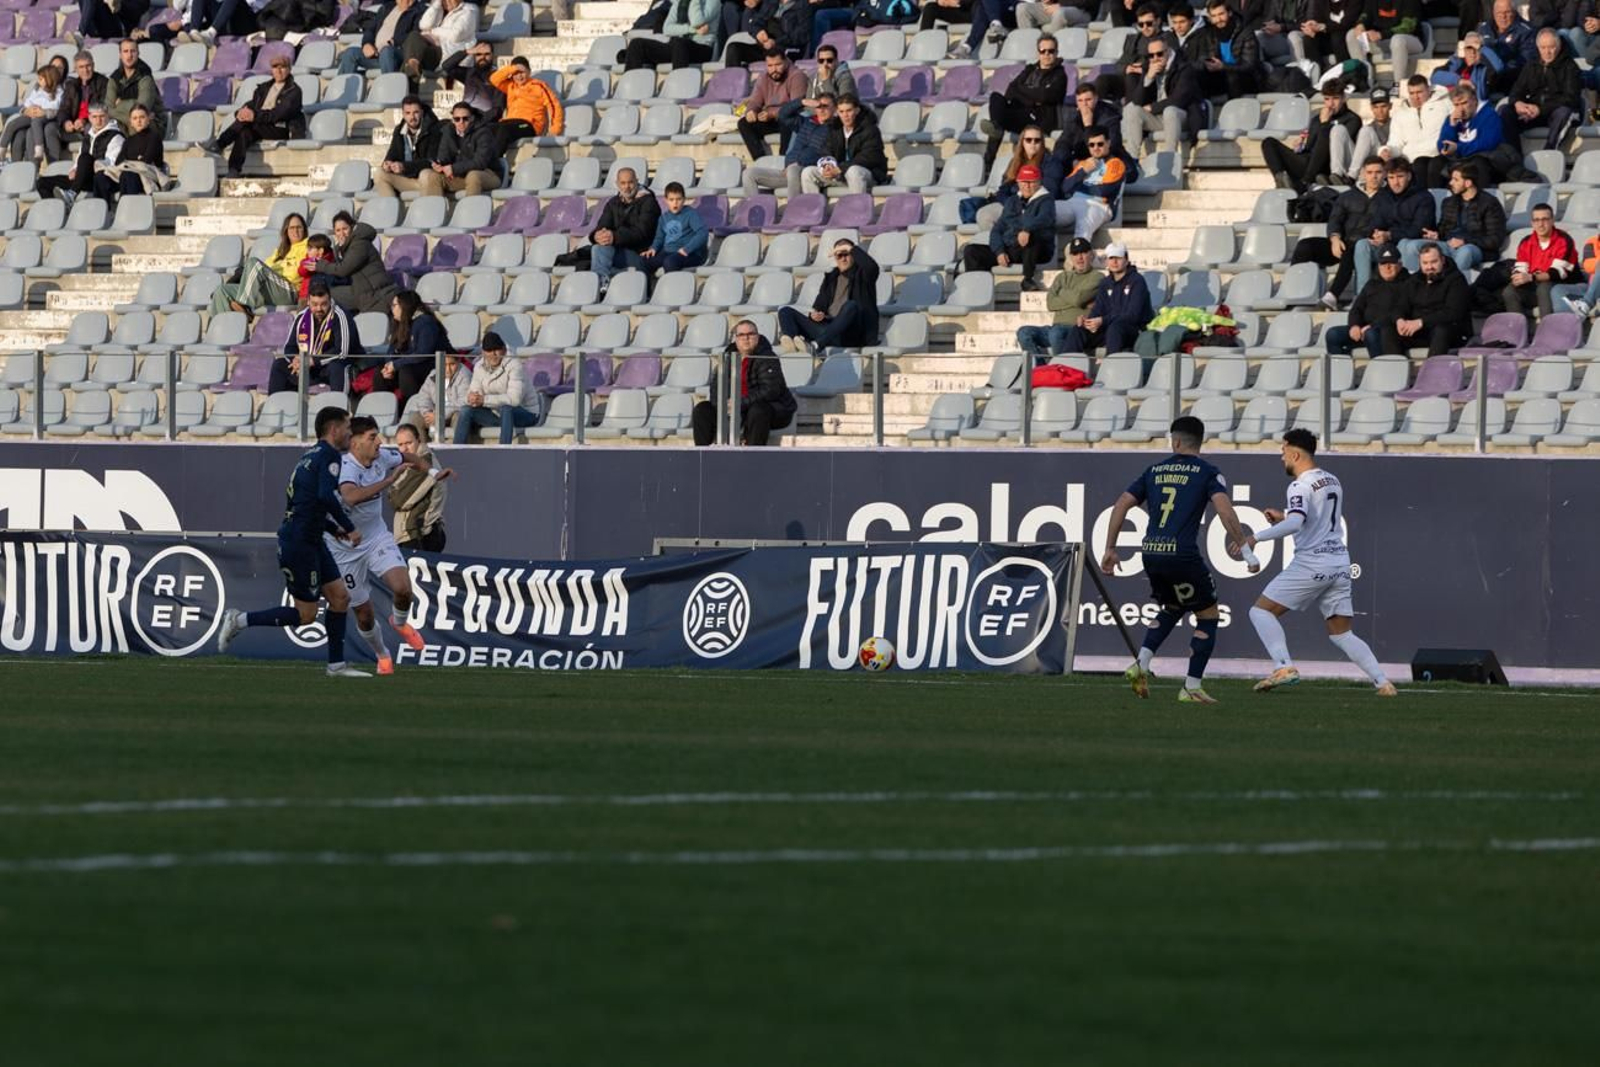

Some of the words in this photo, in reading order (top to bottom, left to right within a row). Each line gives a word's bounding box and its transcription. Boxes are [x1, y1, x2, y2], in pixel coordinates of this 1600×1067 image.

[1159, 487, 1177, 528] 7
[1327, 492, 1338, 532] 7
[0, 541, 129, 653] UTUR
[345, 573, 356, 590] 9
[407, 557, 630, 636] SEGUNDA
[396, 643, 623, 670] FEDERACIÓN
